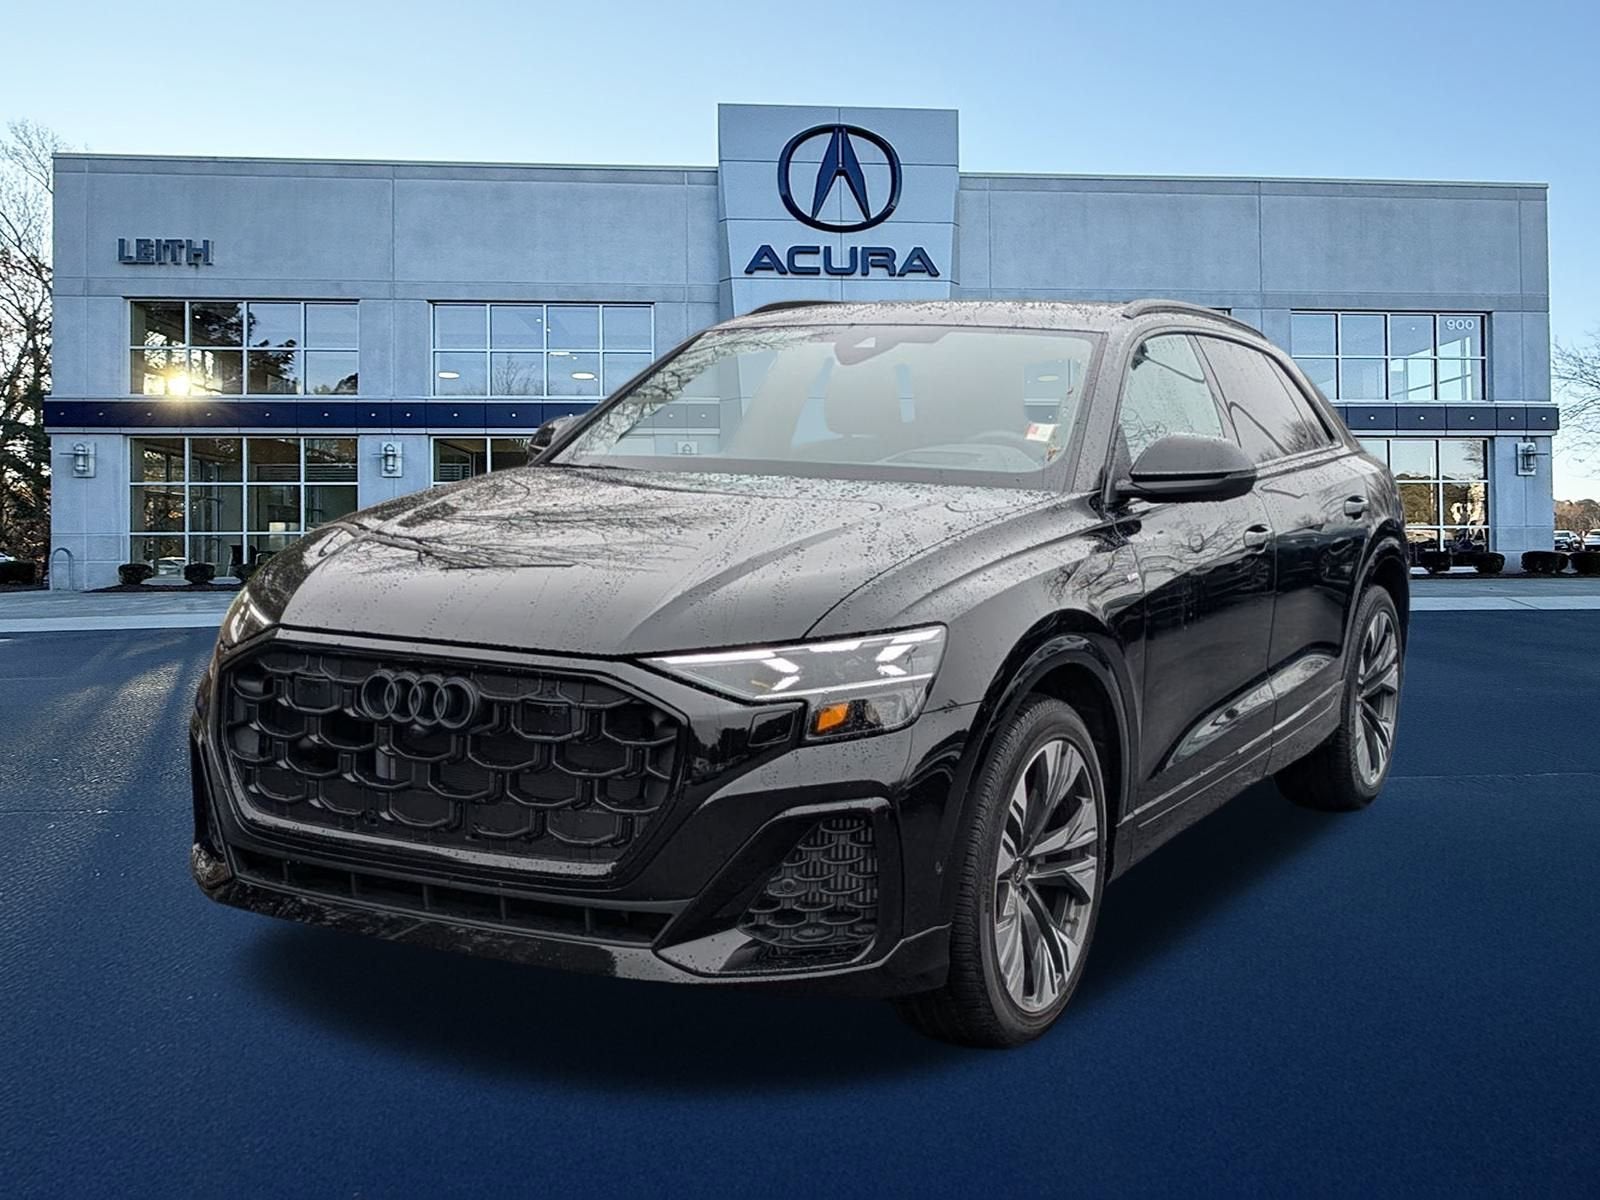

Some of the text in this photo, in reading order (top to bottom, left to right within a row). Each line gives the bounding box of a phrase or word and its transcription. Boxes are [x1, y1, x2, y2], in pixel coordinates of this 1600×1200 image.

[117, 238, 212, 264] LEITH
[744, 244, 940, 278] ACURA
[1446, 319, 1474, 330] 900
